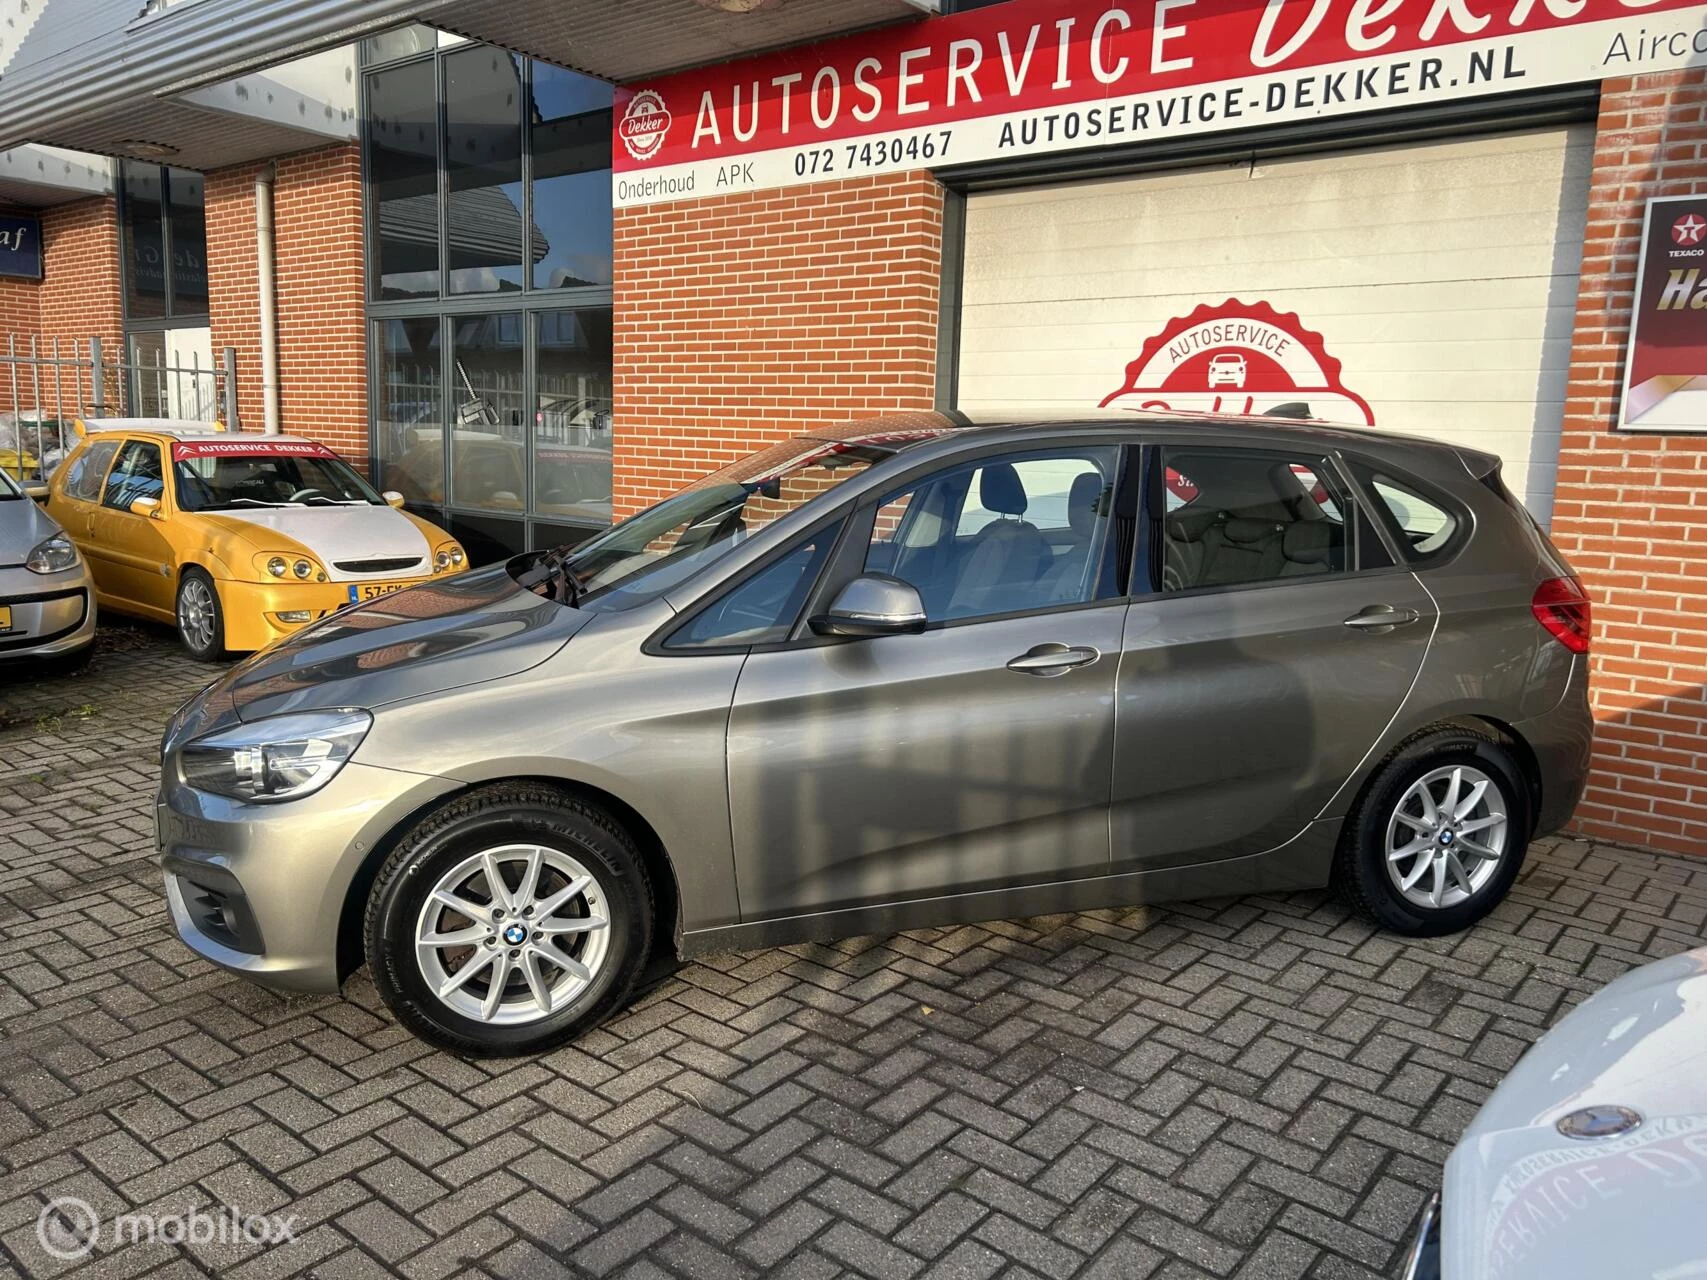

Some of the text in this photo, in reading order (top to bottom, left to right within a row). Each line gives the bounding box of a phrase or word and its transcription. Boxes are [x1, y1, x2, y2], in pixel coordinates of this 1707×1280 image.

[692, 0, 1195, 148] AUTOSERVICE
[999, 46, 1525, 148] AUTOSERVICE-DEKKER.NL
[628, 116, 663, 134] Dekker
[795, 131, 952, 177] 072 7430467
[618, 170, 695, 201] Onderhoud
[716, 162, 755, 188] APK
[1669, 249, 1704, 258] TEXACO
[1169, 324, 1290, 364] AUTOSERVICE
[198, 444, 316, 453] AUTOSERVICE DEKKER
